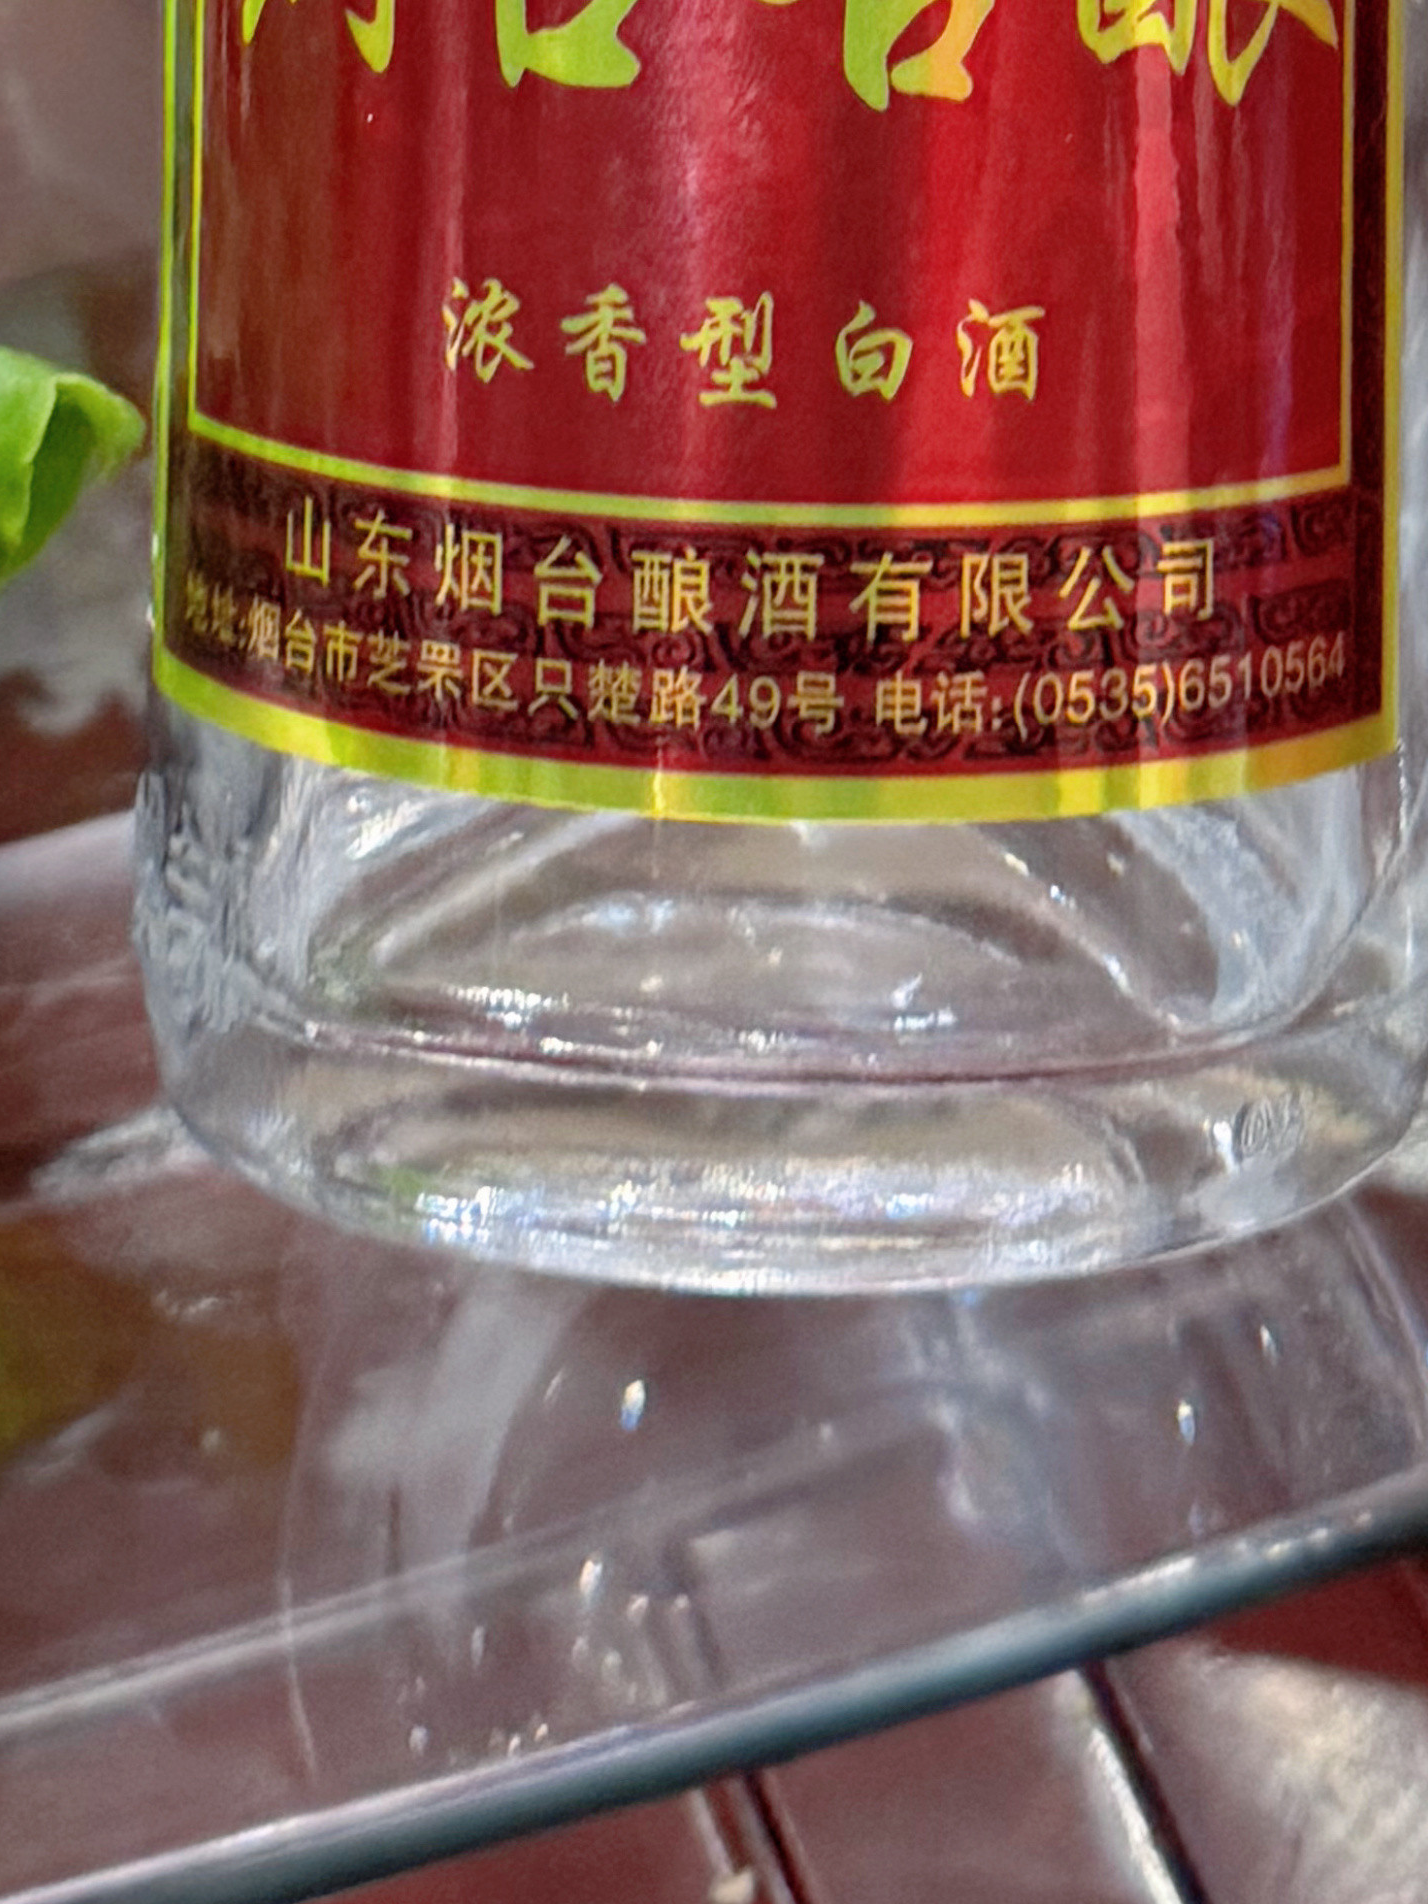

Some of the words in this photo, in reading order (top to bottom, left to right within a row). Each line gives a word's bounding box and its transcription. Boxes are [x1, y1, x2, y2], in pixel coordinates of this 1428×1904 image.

[440, 277, 1047, 409] 浓香型白酒
[283, 494, 1220, 644] 山东烟台酿酒有限公司
